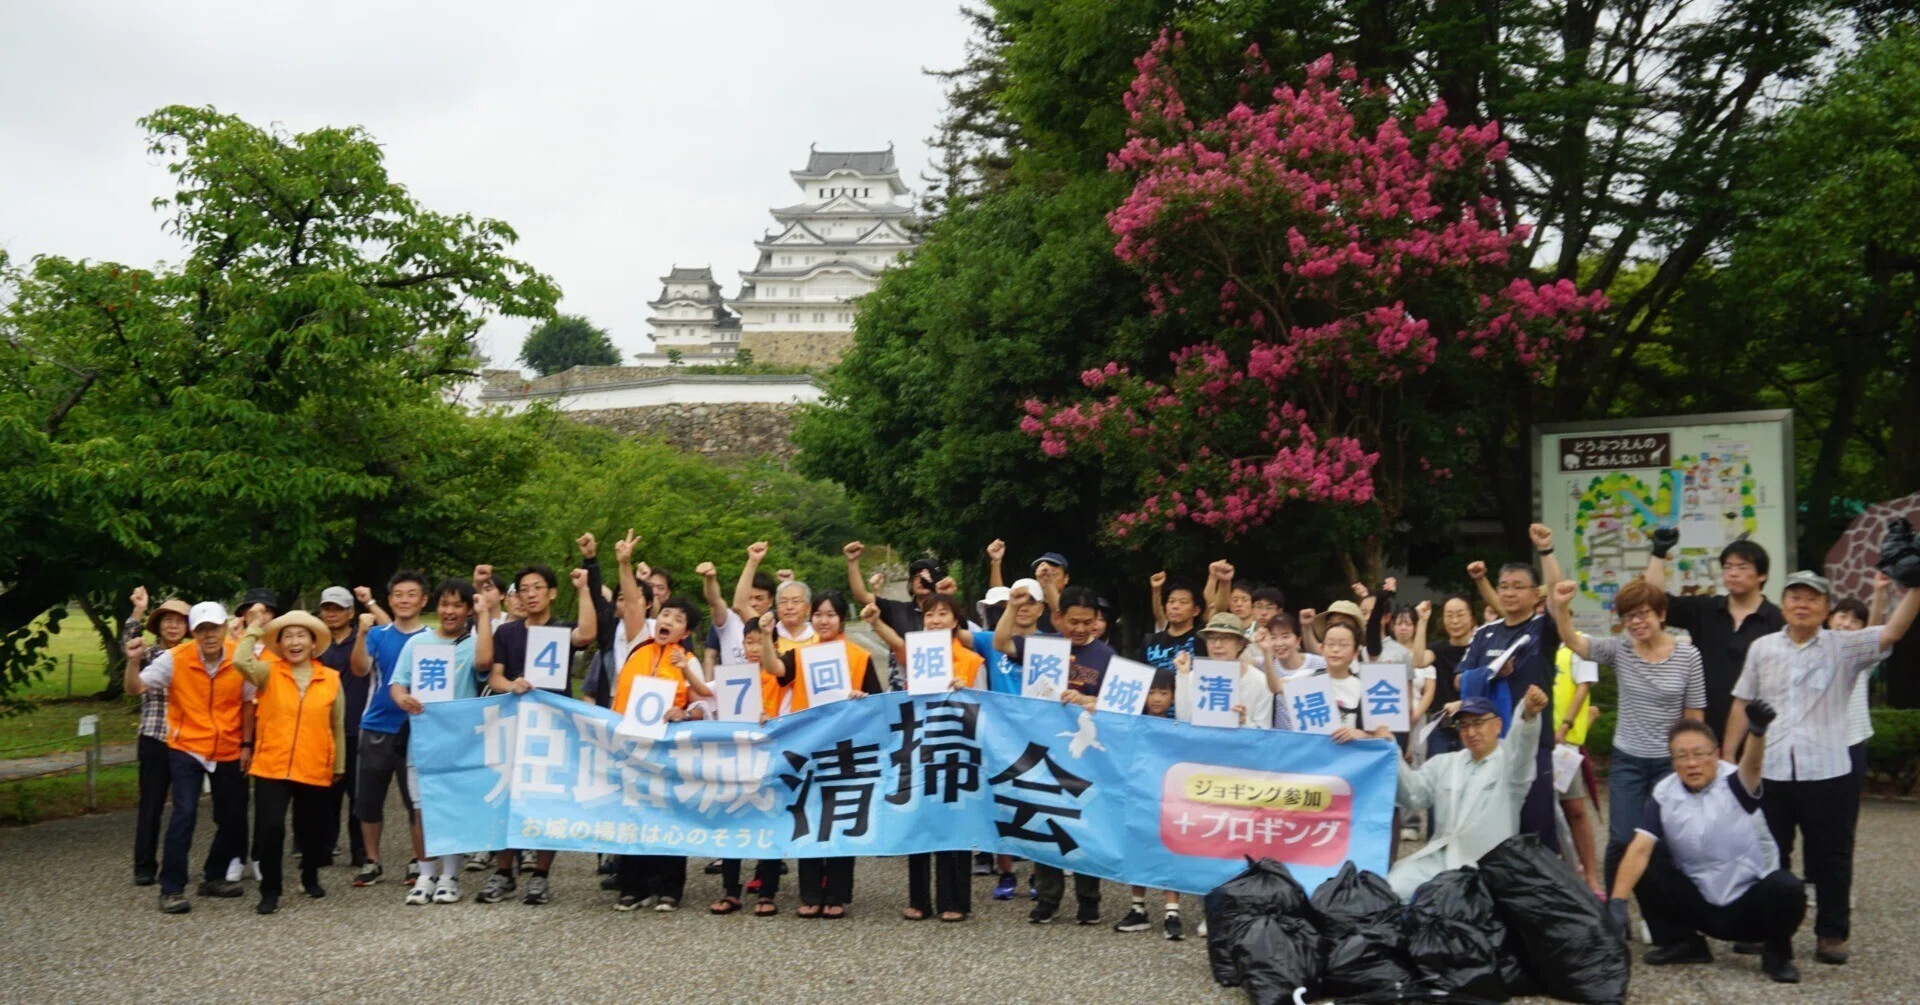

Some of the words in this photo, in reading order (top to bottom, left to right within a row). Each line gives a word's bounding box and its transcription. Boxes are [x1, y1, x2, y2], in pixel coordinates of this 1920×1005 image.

[1574, 437, 1657, 453] どうぶつえんの
[1585, 453, 1645, 467] ごあんない
[418, 658, 448, 691] 第
[534, 641, 560, 676] 4
[912, 646, 947, 679] 姫
[1028, 654, 1062, 685] 路
[809, 659, 844, 694] 回
[1198, 675, 1233, 712] 清
[635, 691, 665, 725] 0
[726, 678, 752, 715] 7
[1104, 675, 1142, 713] 城
[1293, 691, 1331, 731] 掃
[1367, 679, 1401, 715] 会
[1196, 780, 1322, 807] ジョギング参加
[522, 817, 776, 849] お城の掃除は心のそうじ
